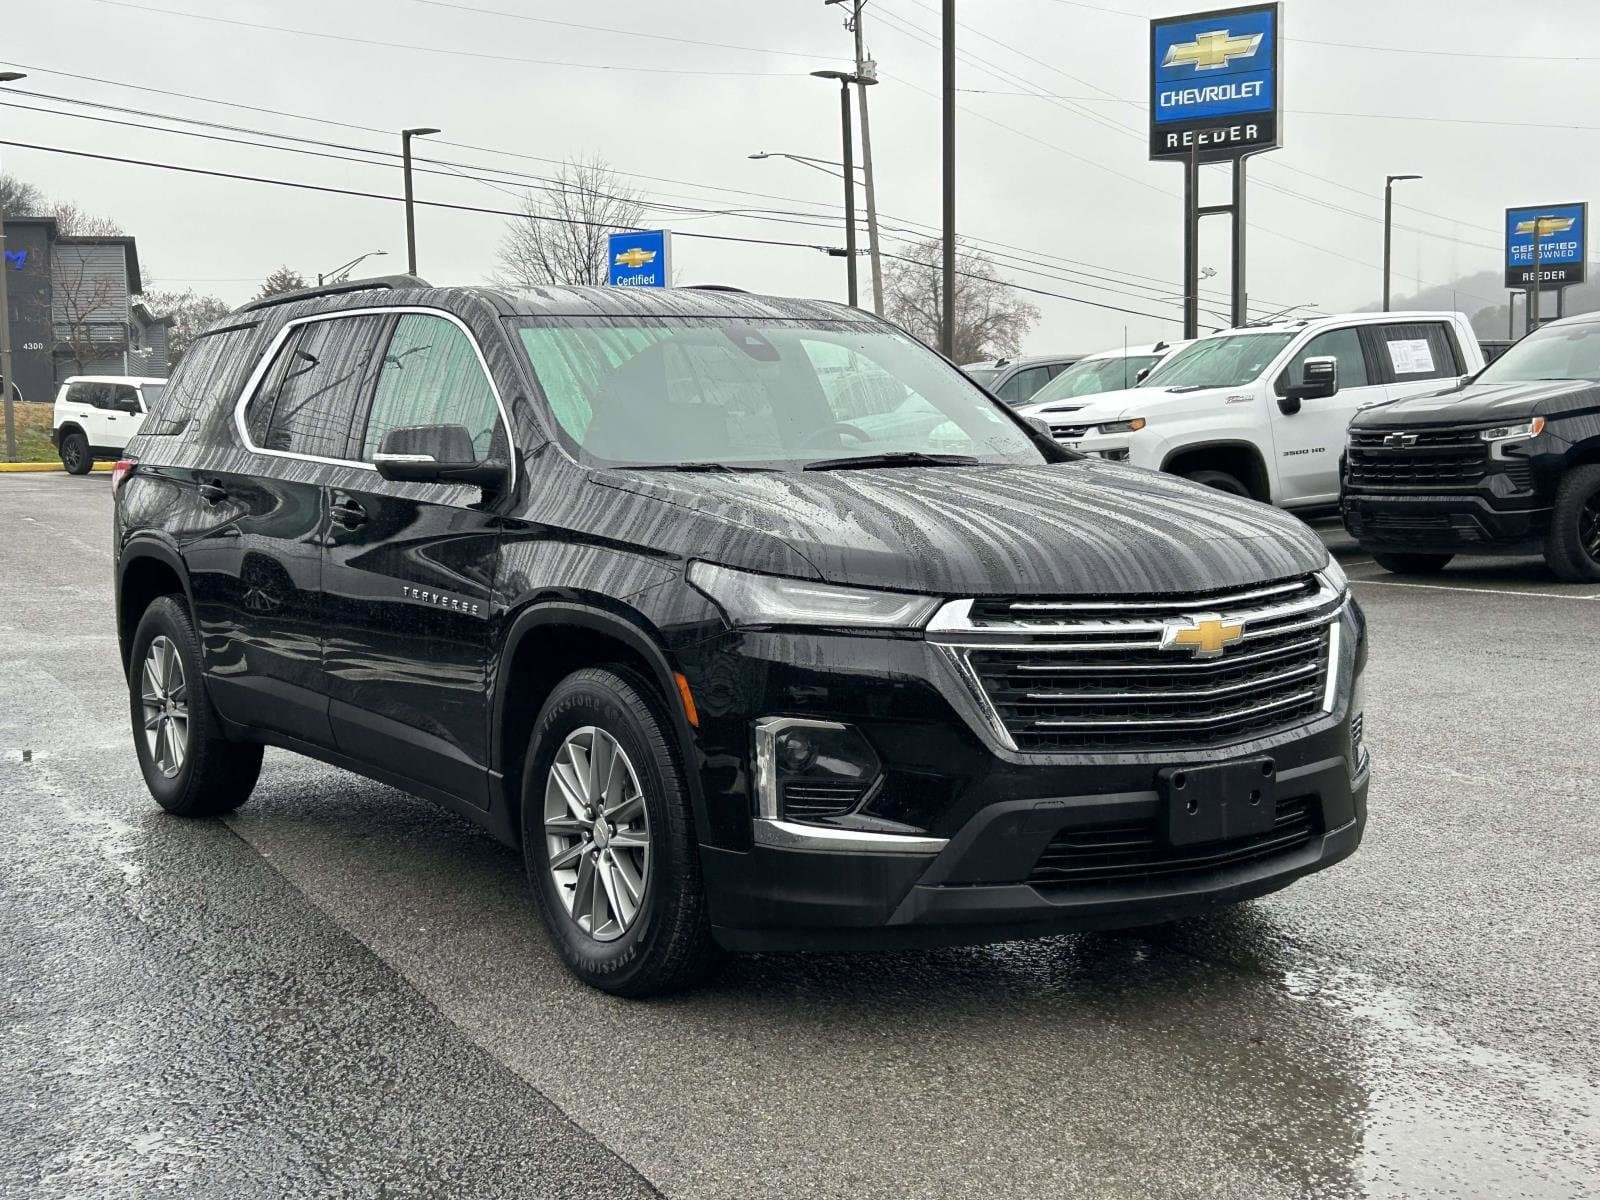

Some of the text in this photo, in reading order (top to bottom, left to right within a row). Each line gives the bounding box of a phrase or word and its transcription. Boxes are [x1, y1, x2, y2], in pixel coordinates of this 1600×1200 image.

[1160, 80, 1264, 107] CHEVROLET
[1167, 124, 1258, 148] REEDER
[1511, 241, 1577, 253] CERTIFIED
[616, 273, 655, 286] Certified
[1522, 270, 1565, 281] REEDER
[1282, 448, 1309, 456] 3500
[403, 586, 479, 616] TRAVERSE
